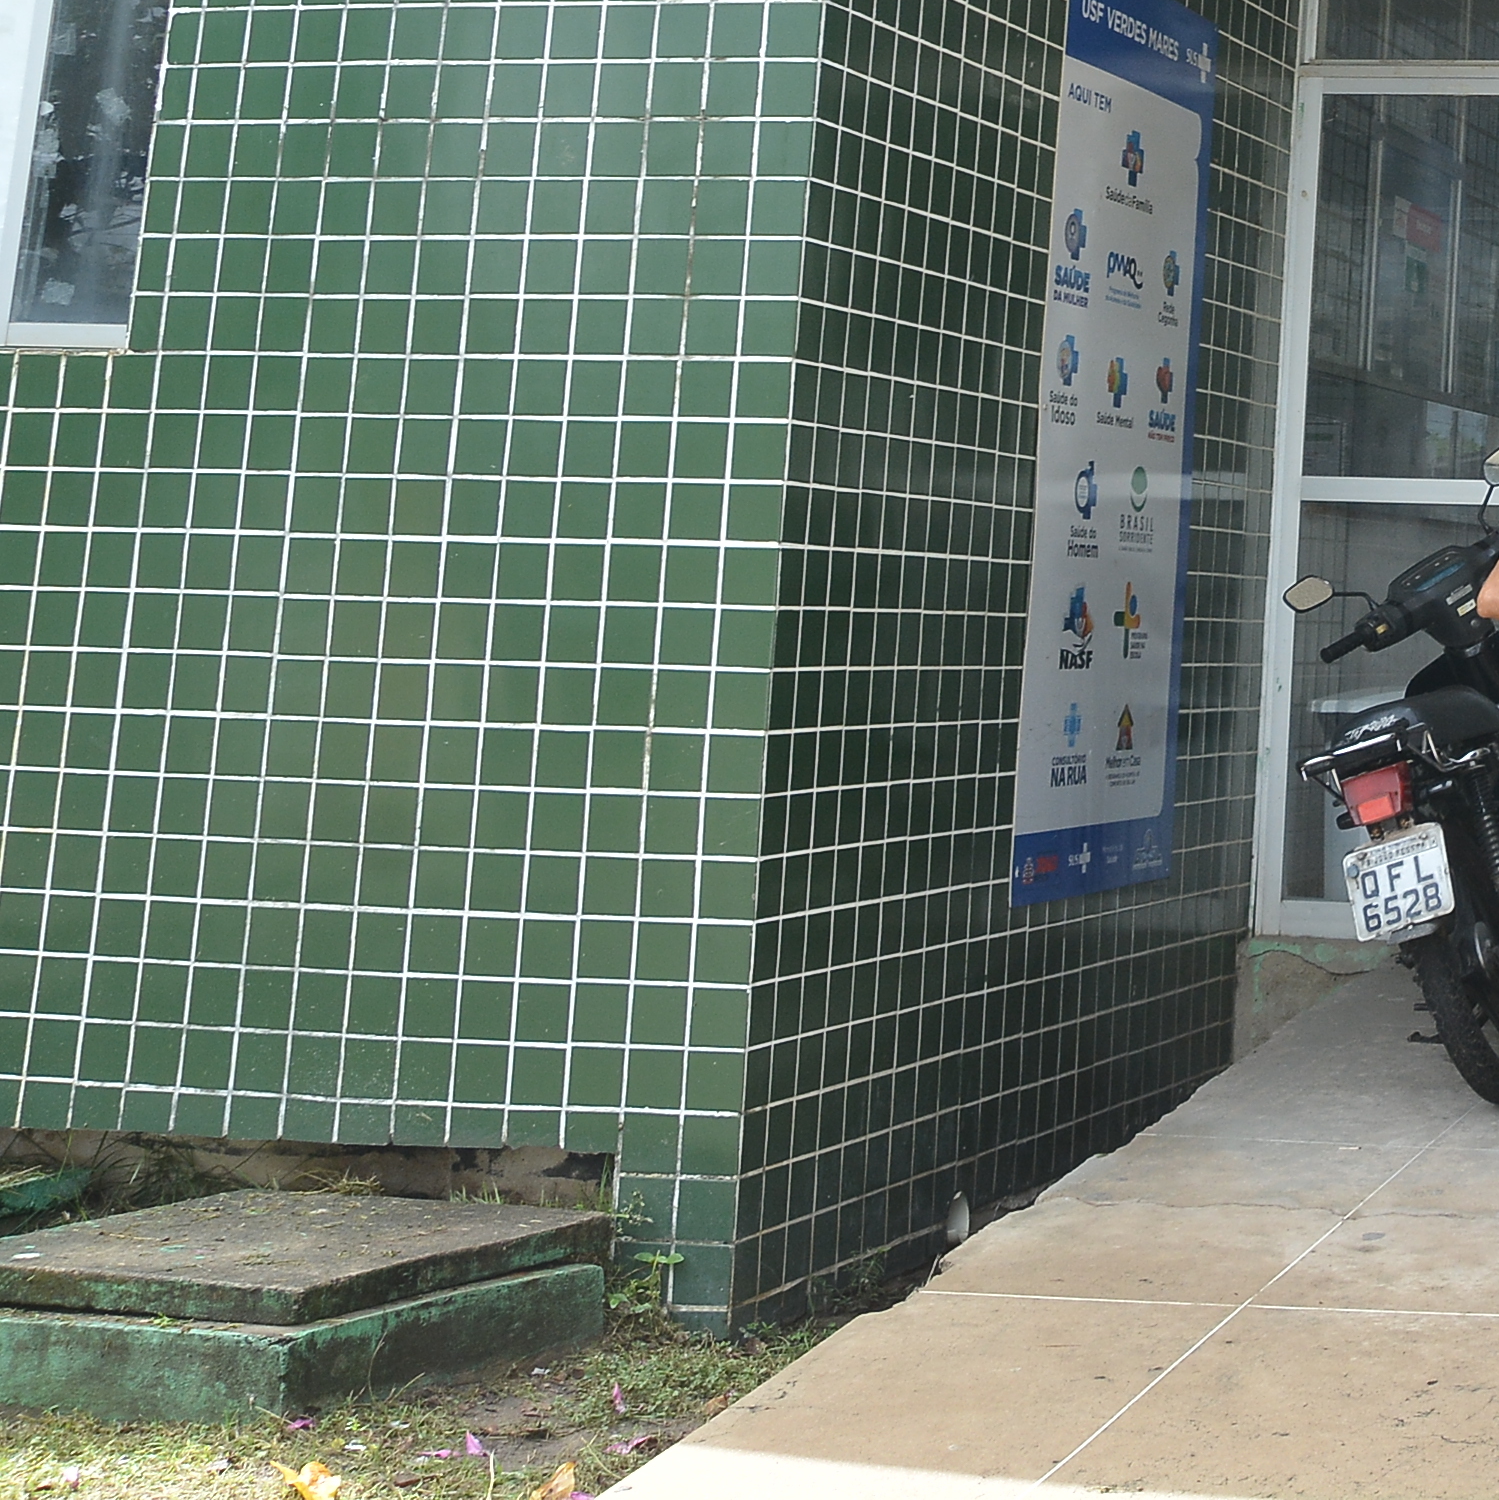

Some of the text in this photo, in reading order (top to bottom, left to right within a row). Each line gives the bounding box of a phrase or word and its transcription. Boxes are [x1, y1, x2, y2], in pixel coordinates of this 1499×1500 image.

[1107, 6, 1147, 45] VERDES
[1148, 27, 1179, 61] MARES
[1068, 82, 1112, 113] AQUI TEM
[1054, 264, 1091, 293] SAÚDE
[1054, 289, 1063, 302] DA
[1063, 292, 1088, 308] MULHER
[1049, 390, 1078, 406] Saúde do
[1051, 404, 1076, 426] Idoso
[1096, 411, 1114, 426] Saúde
[1148, 408, 1176, 432] SAÚDE
[1070, 524, 1097, 539] Saúde do
[1120, 513, 1154, 532] BRASIL
[1067, 540, 1099, 558] Homem
[1059, 649, 1093, 669] NASF
[1050, 765, 1087, 787] NA RUA
[1360, 855, 1434, 900] QFL
[1362, 882, 1442, 933] 6528
